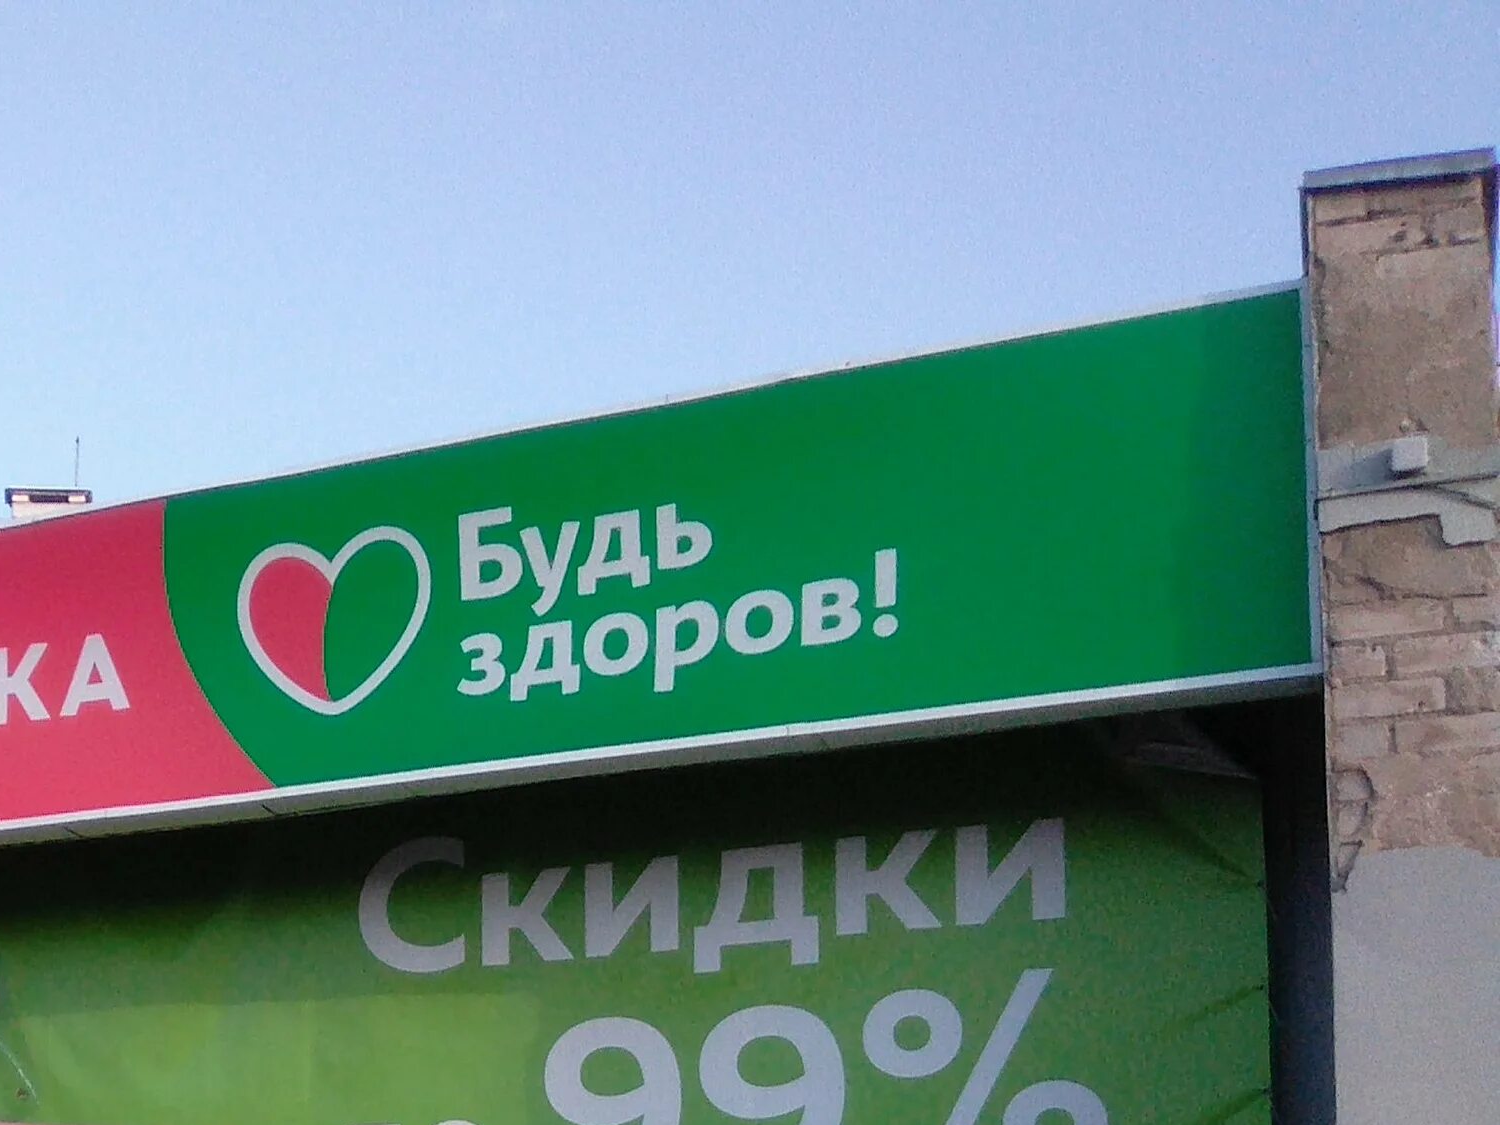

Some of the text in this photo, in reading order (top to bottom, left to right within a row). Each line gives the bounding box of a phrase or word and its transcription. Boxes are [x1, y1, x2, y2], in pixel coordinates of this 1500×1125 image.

[456, 548, 899, 702] здоров!
[457, 502, 713, 617] Будь
[357, 816, 1068, 974] Скидки
